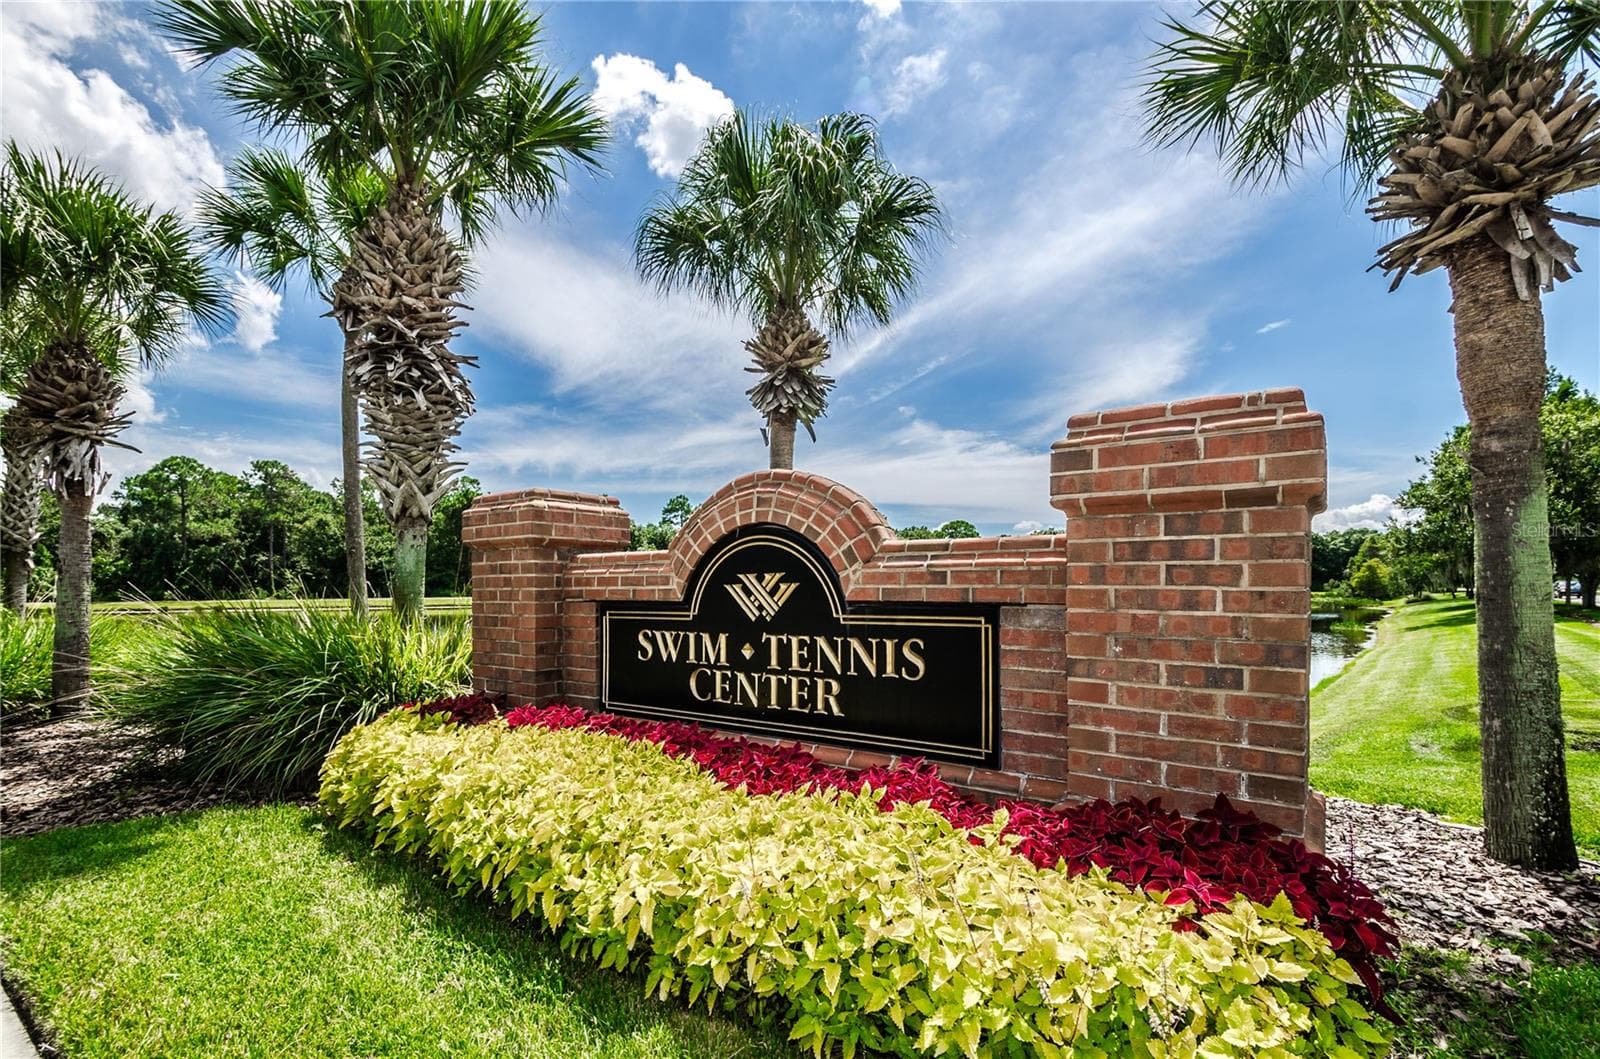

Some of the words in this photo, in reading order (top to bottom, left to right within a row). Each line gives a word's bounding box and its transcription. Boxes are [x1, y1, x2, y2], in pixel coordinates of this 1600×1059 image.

[637, 629, 729, 666] SWIM
[761, 632, 925, 681] TENNIS
[689, 668, 845, 716] CENTER
